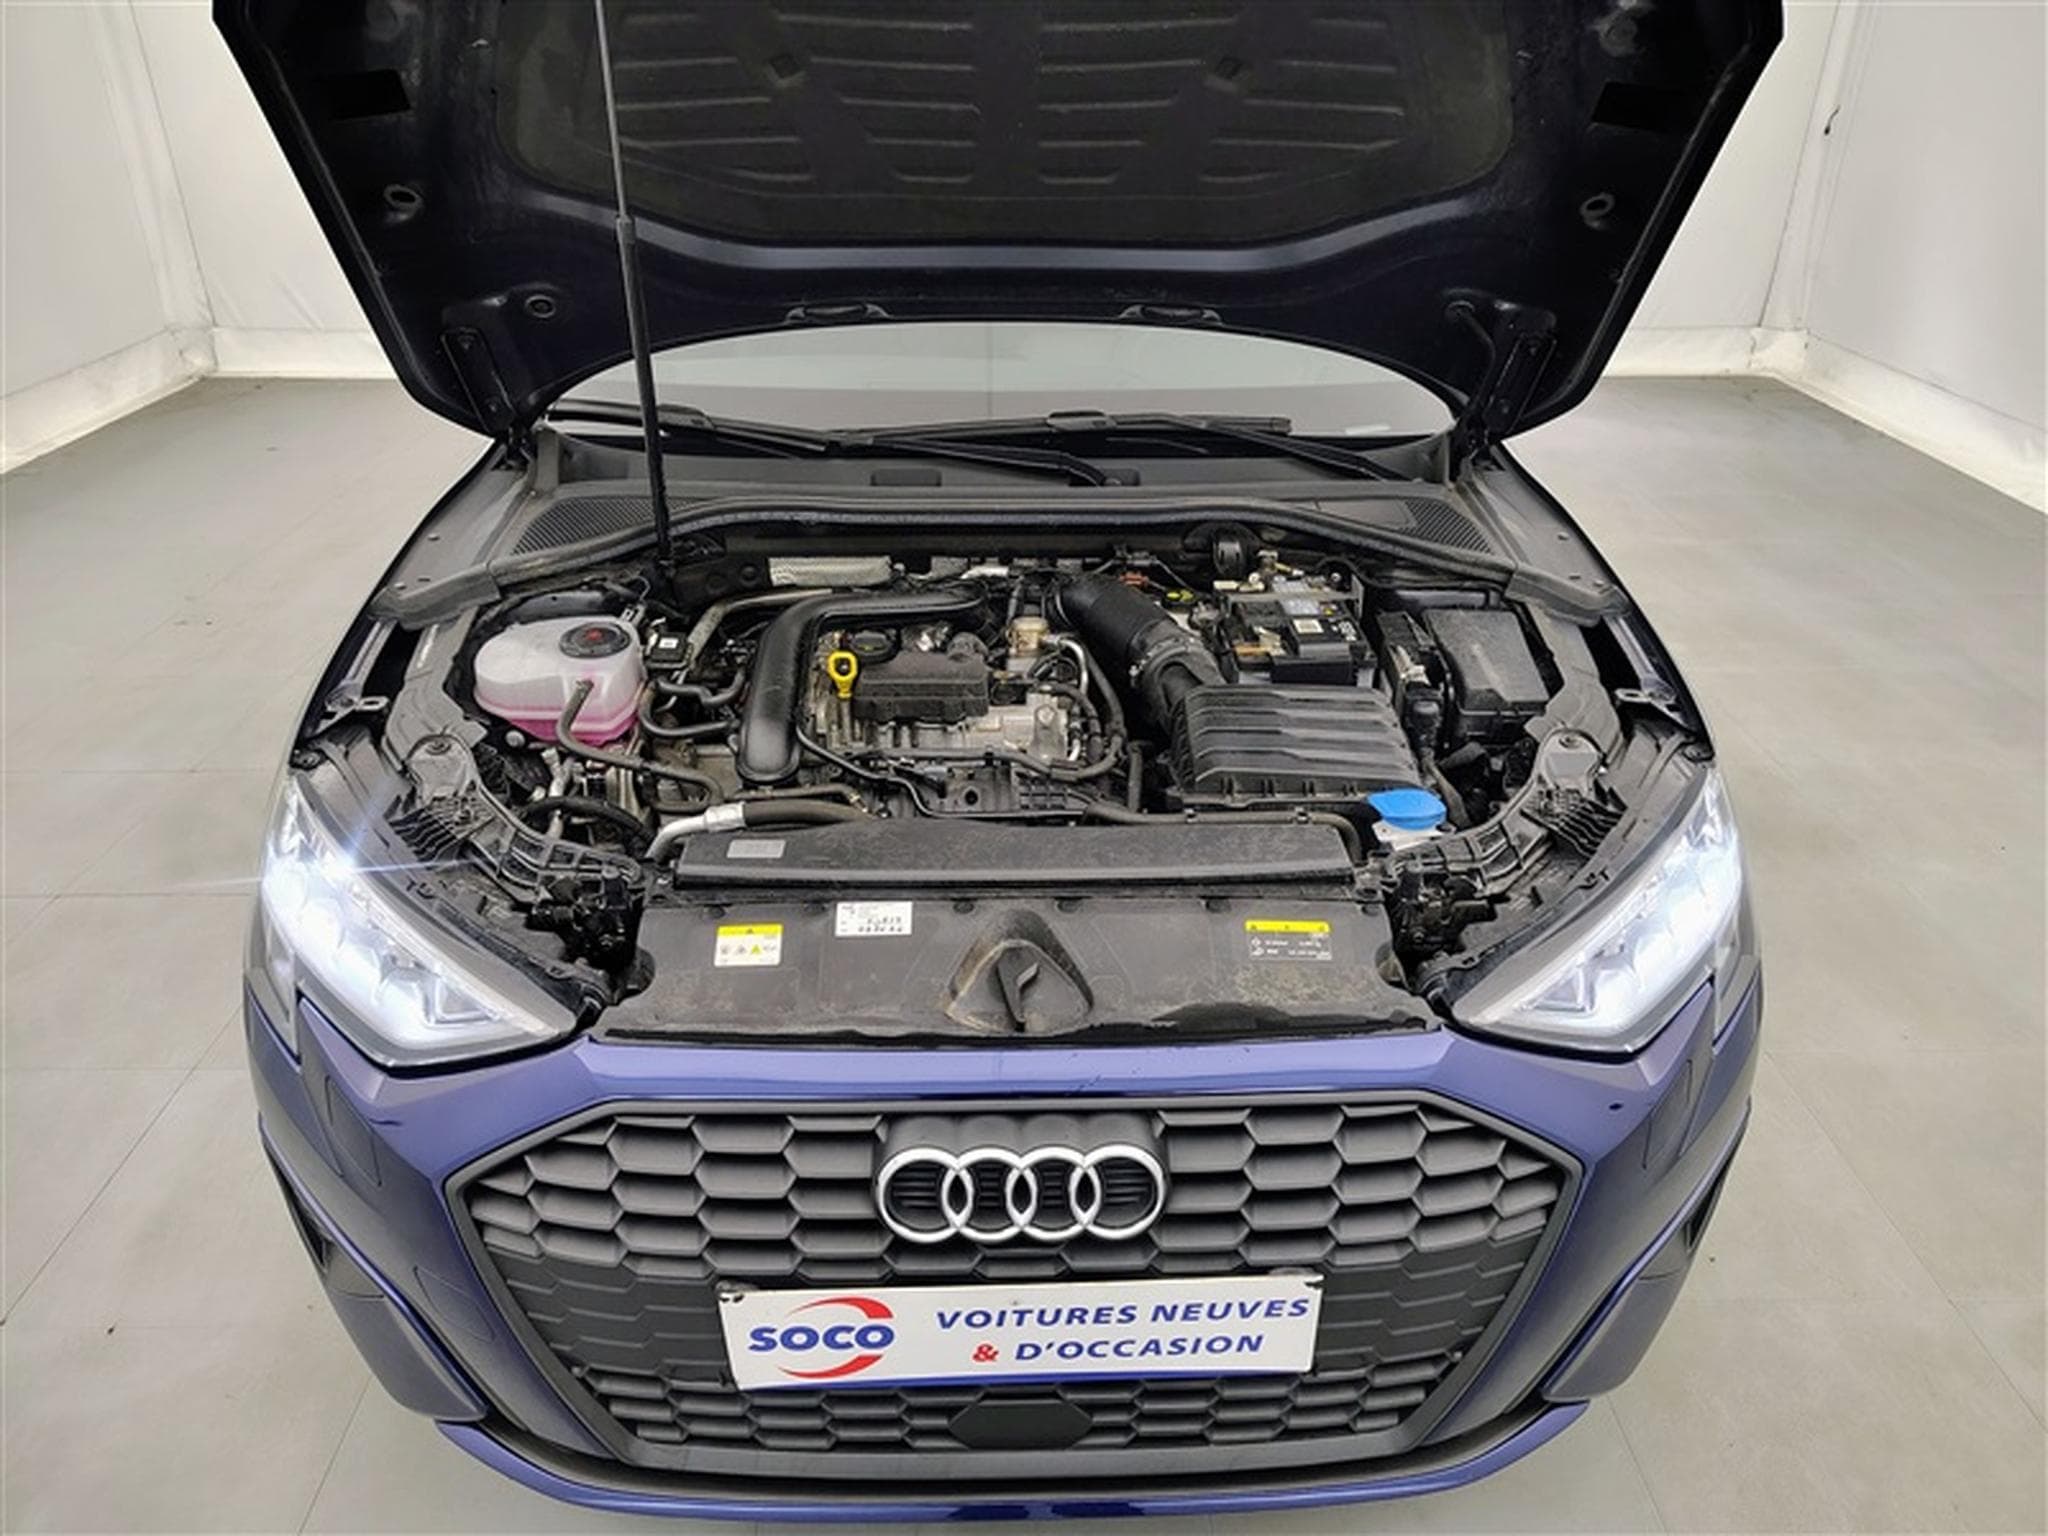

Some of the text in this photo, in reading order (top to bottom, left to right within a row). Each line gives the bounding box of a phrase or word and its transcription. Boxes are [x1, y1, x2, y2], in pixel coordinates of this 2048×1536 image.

[938, 1299, 1309, 1330] VOITURES NEUVES
[749, 1324, 896, 1353] SOCO
[972, 1335, 1264, 1363] & D'OCCASION
